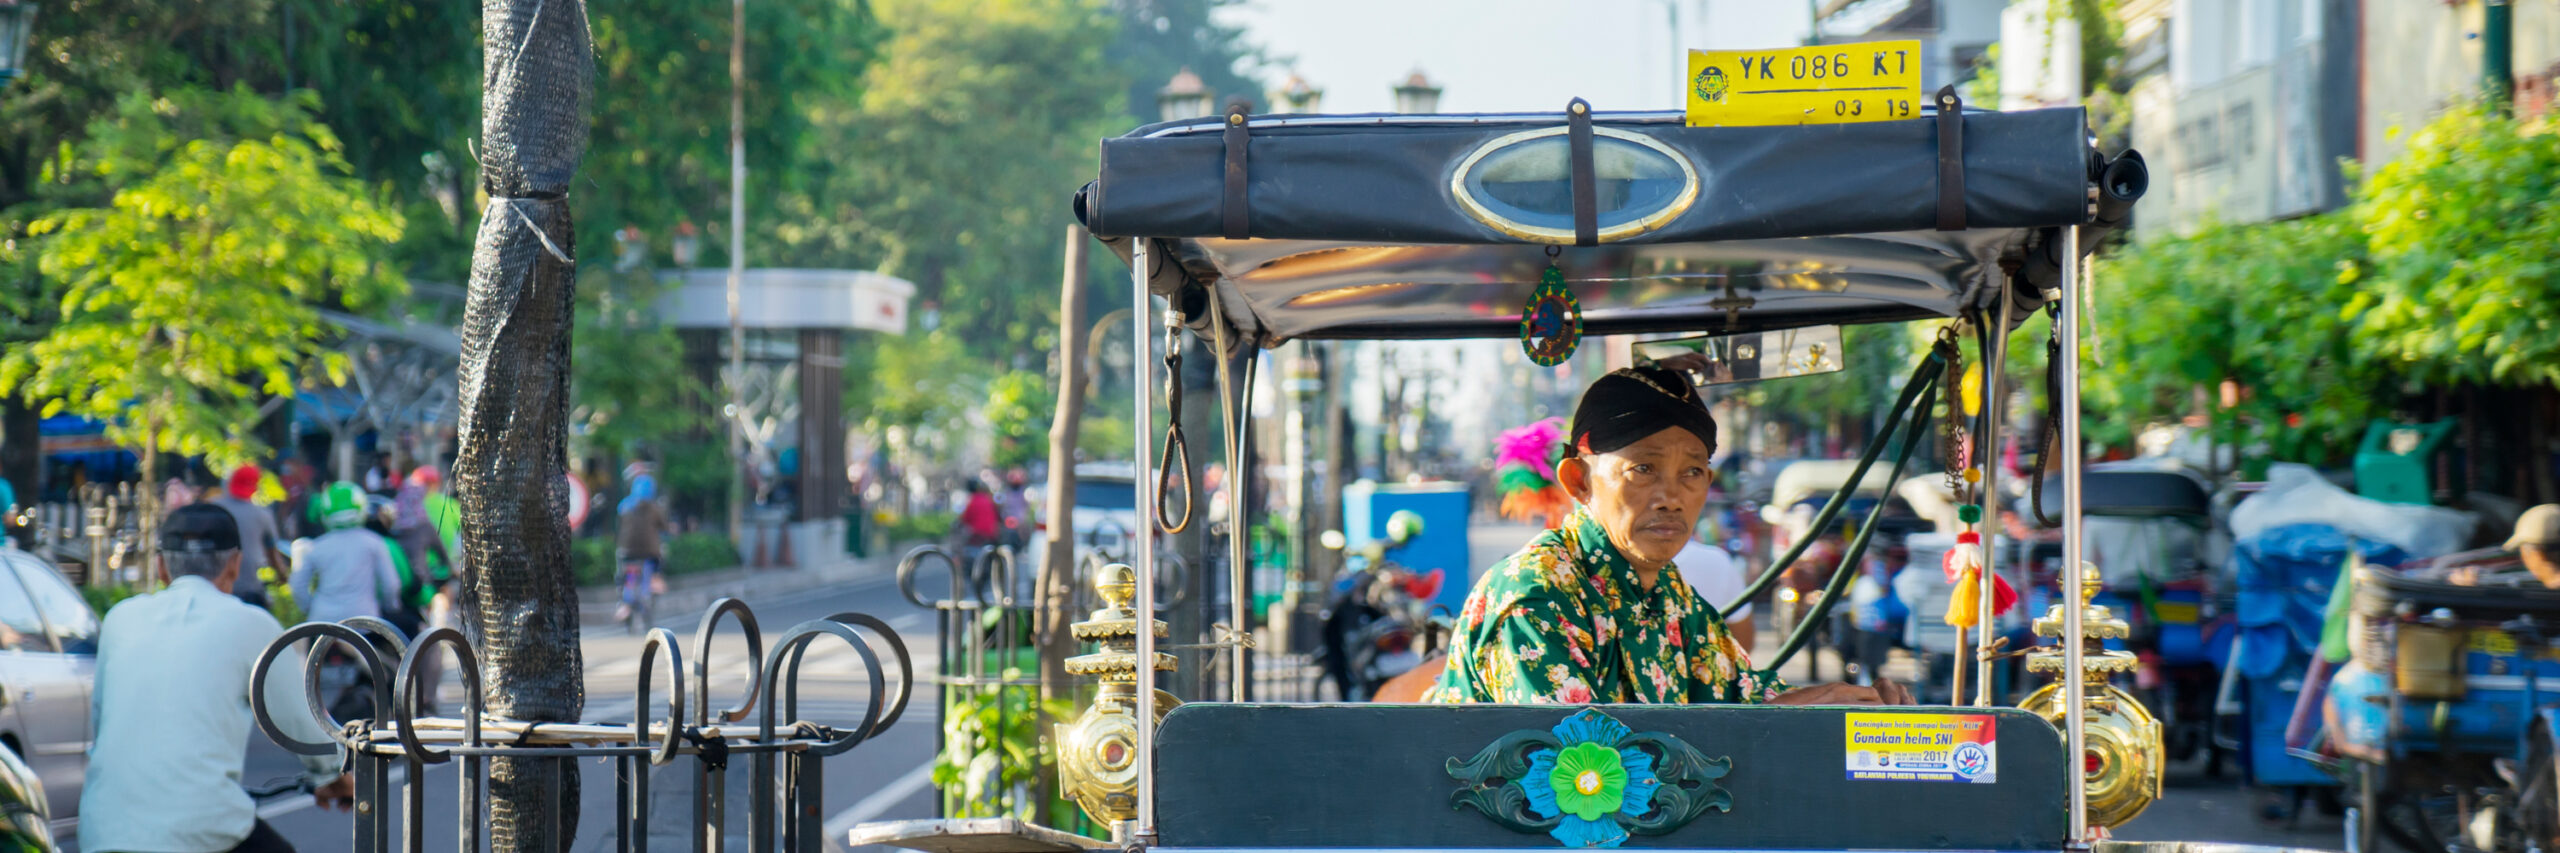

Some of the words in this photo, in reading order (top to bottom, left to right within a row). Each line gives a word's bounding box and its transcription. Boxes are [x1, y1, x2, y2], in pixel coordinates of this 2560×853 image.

[1739, 56, 1775, 80] YK
[1791, 53, 1849, 79] 086
[1873, 51, 1908, 76] KT
[1835, 99, 1862, 116] 03
[1887, 99, 1909, 117] 19
[1854, 731, 1902, 744] Gunakan
[1904, 731, 1931, 744] helm
[1934, 733, 1953, 745] SNI
[1923, 750, 1948, 762] 2017
